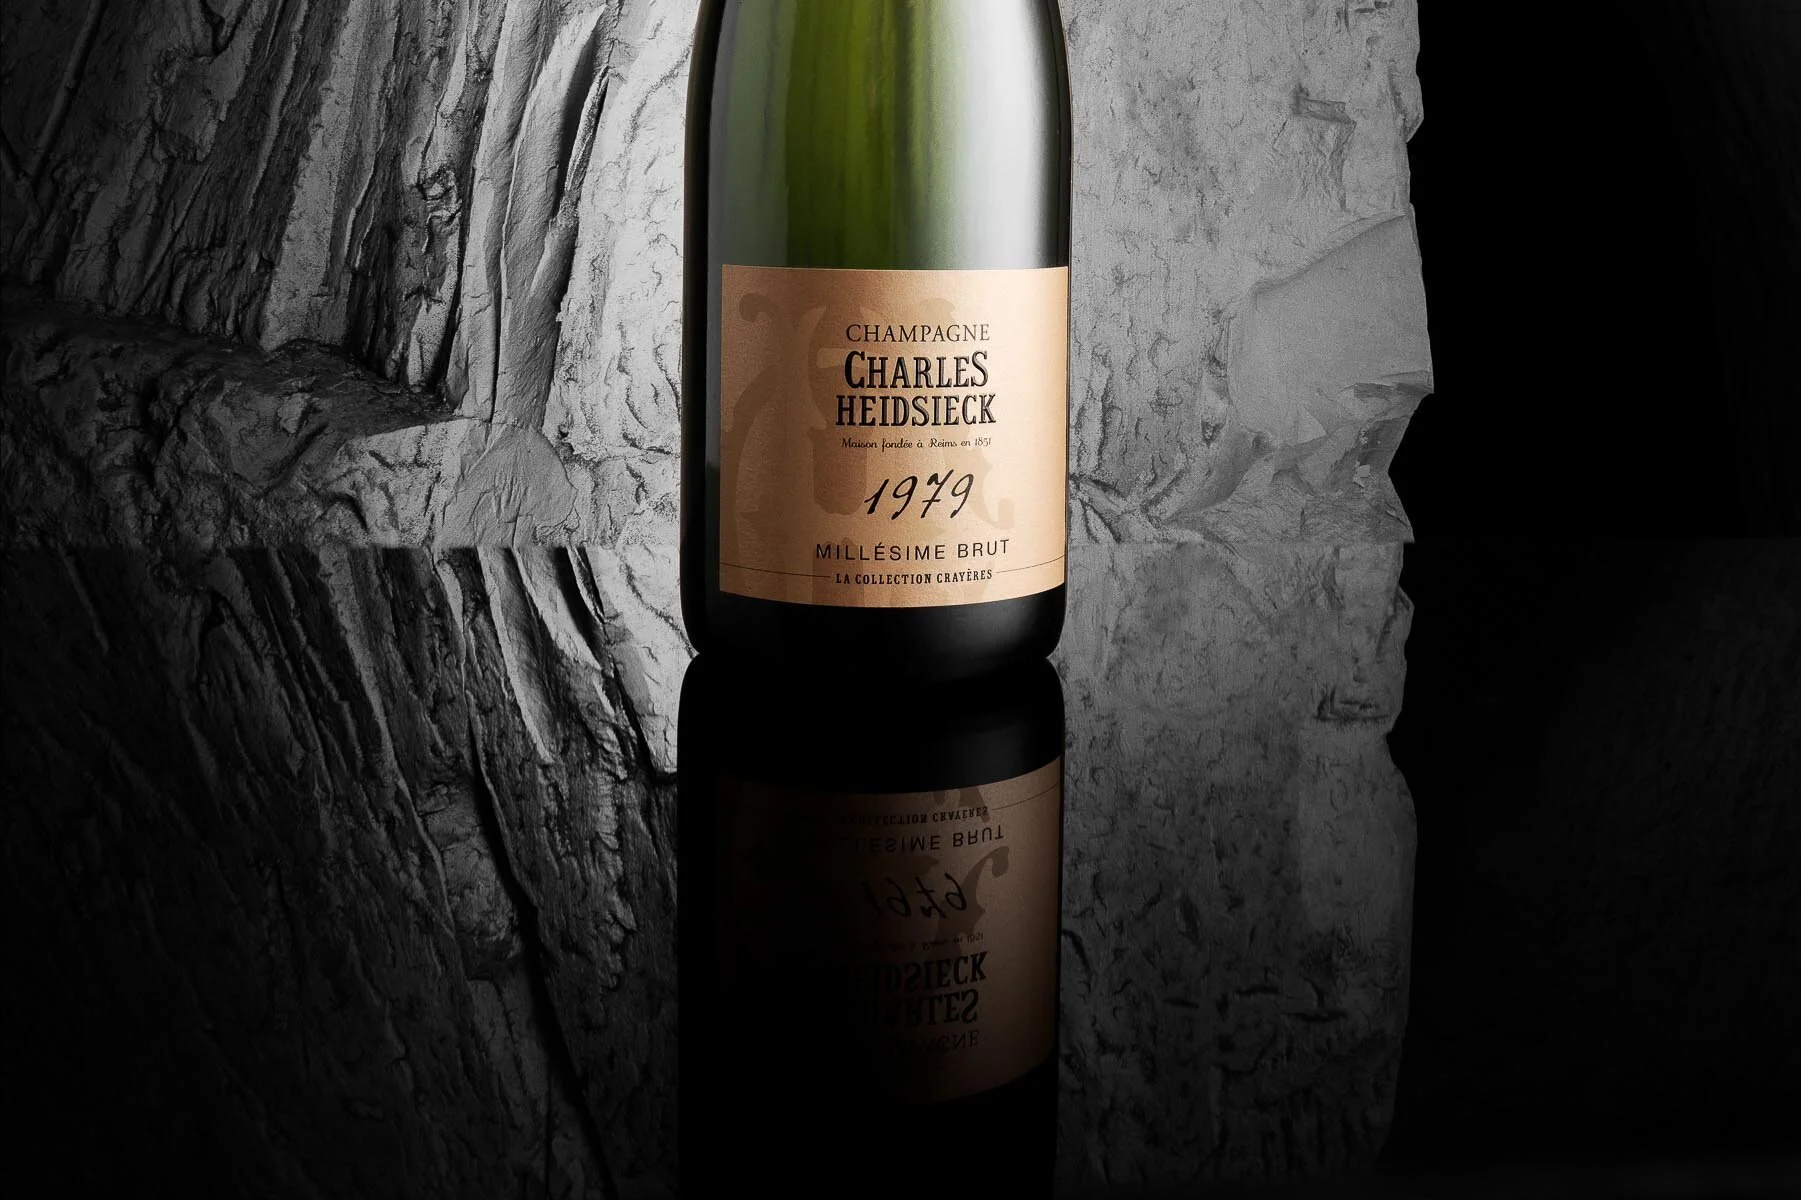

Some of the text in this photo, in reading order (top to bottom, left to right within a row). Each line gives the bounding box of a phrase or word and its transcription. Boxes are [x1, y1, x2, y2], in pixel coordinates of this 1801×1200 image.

[846, 323, 991, 343] CHAMPAGNE
[844, 350, 989, 389] CHARLES
[835, 393, 997, 427] HEIDSIECK
[841, 437, 878, 449] Maison
[882, 437, 913, 453] fondée
[916, 439, 924, 449] à
[928, 438, 958, 448] Reims
[974, 436, 992, 447] 1851
[864, 468, 975, 521] 1979
[815, 538, 1010, 561] MILLÉSIME BRUT
[835, 568, 993, 585] LA COLLECTION CRAYÈRES
